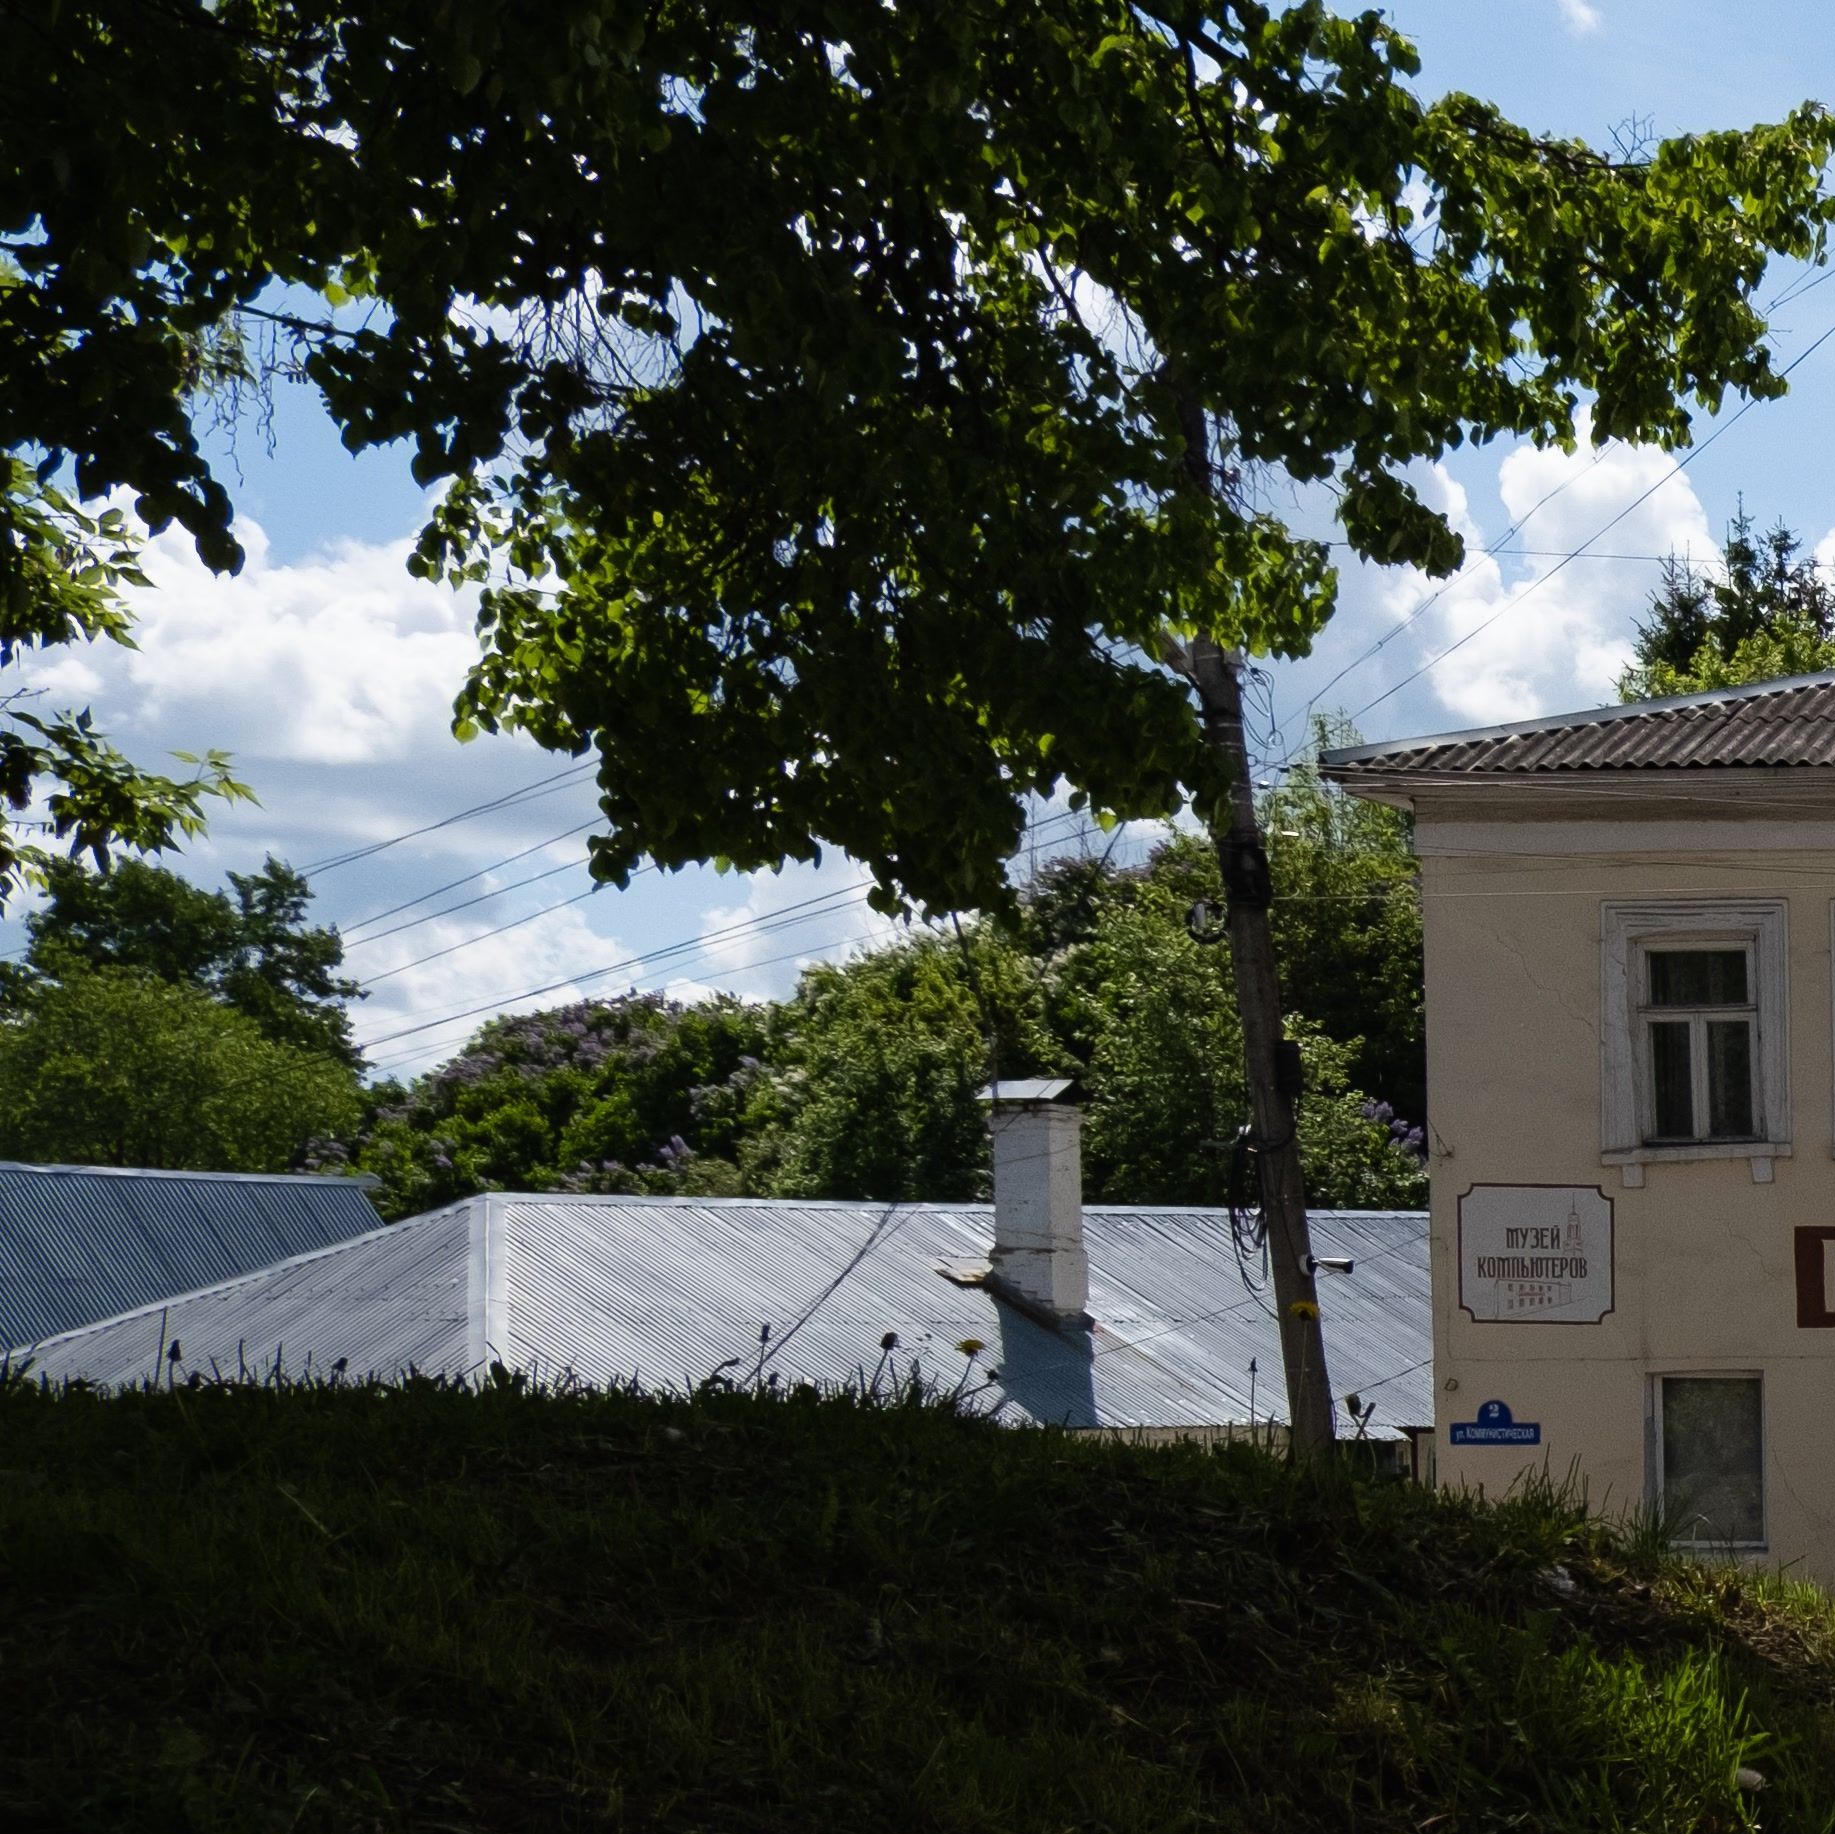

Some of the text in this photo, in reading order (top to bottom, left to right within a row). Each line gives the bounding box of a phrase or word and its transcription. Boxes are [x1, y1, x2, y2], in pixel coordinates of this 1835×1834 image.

[1506, 1225, 1561, 1250] МУЗЕЙ
[1477, 1256, 1588, 1279] КОМПЬЮТЕРОВ
[1488, 1403, 1500, 1418] 2
